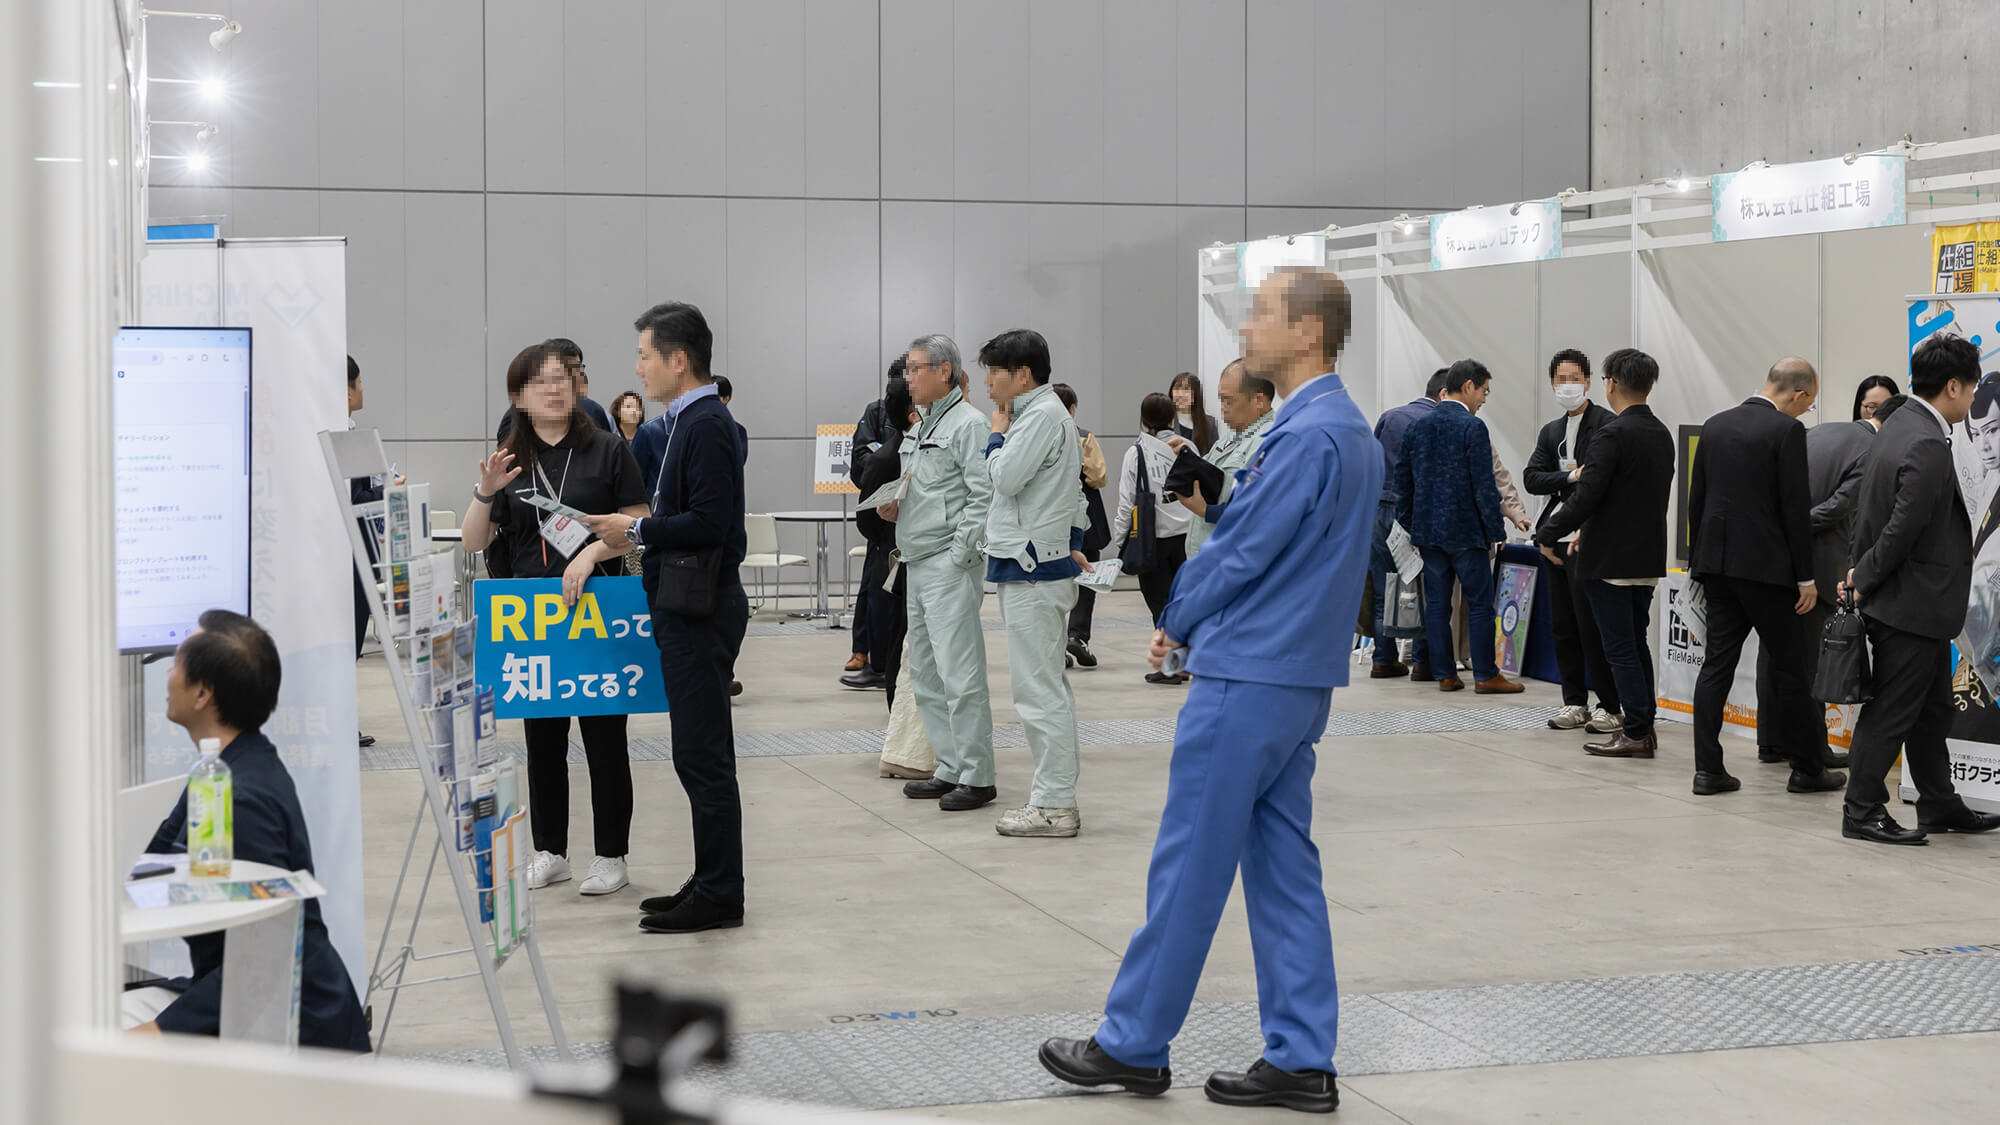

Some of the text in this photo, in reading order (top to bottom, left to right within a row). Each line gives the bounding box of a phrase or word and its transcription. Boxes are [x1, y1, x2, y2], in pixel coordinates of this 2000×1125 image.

[490, 592, 651, 643] RPAって
[1950, 762, 2000, 784] 行クラウ
